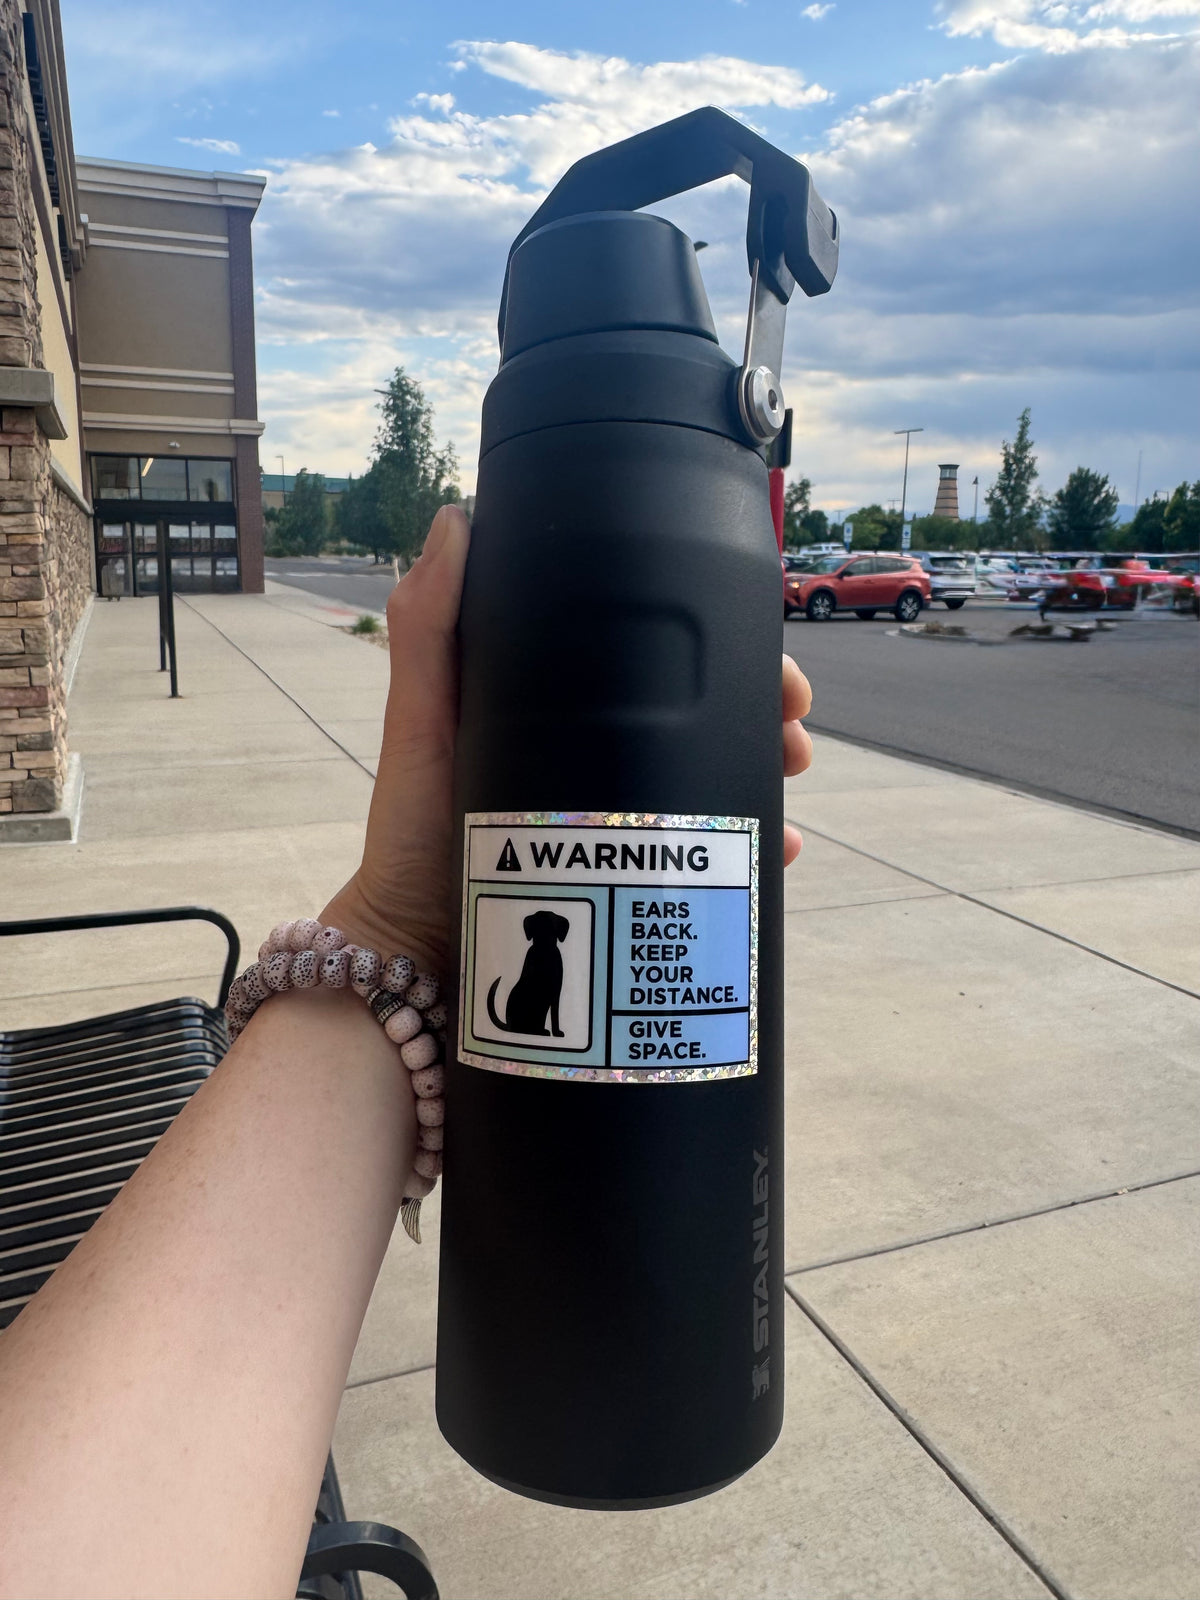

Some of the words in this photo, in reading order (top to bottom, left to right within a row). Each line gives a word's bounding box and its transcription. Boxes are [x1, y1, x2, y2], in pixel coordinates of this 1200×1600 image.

[530, 841, 709, 872] WARNING
[632, 901, 690, 919] EARS
[632, 922, 698, 940] BACK.
[631, 944, 688, 961] KEEP
[630, 965, 693, 983] YOUR
[630, 986, 738, 1006] DISTANCE.
[628, 1020, 682, 1038] GIVE
[628, 1041, 706, 1060] SPACE.
[753, 1149, 769, 1352] STANLEY
